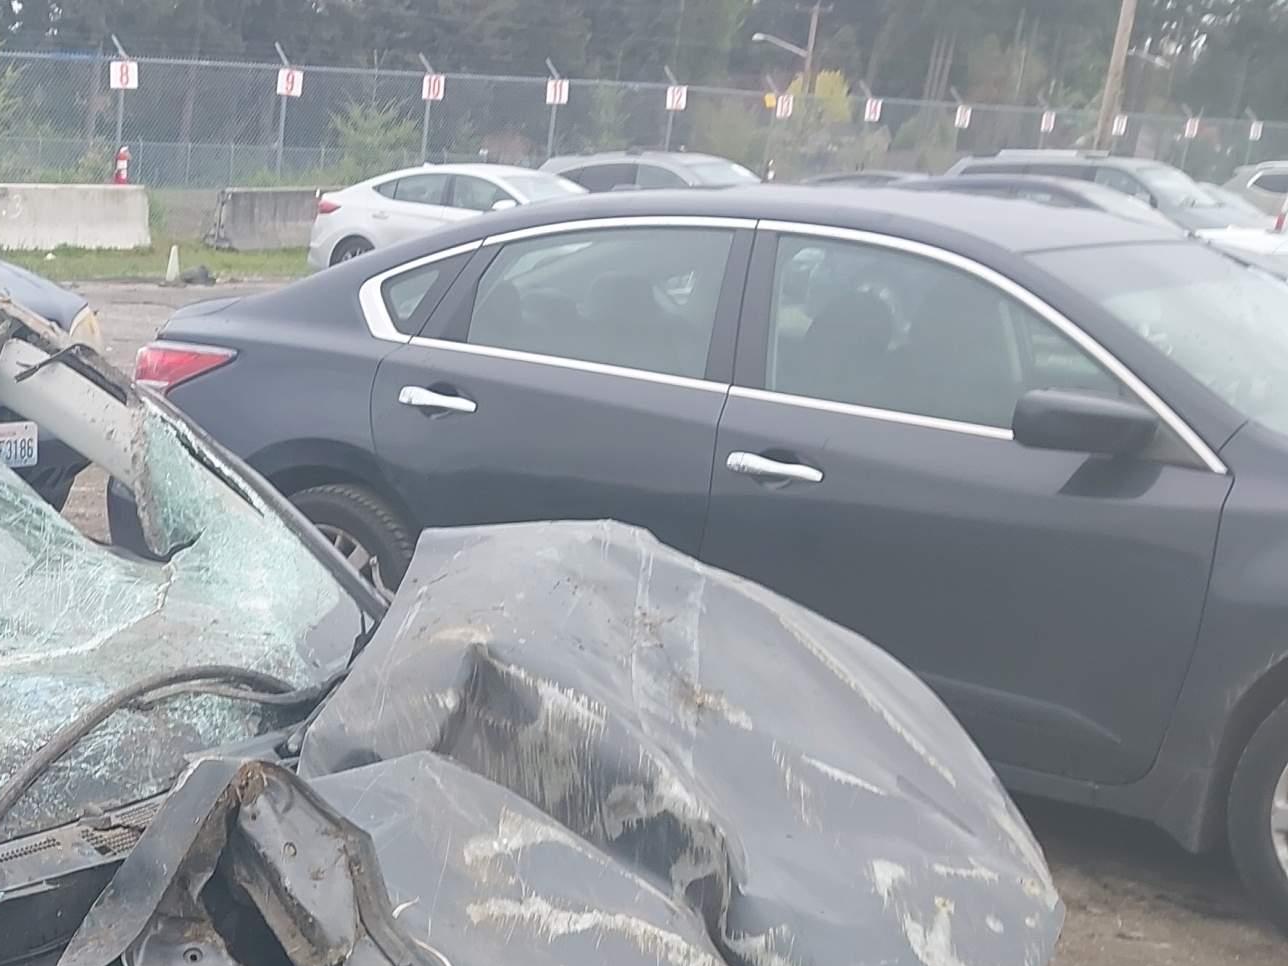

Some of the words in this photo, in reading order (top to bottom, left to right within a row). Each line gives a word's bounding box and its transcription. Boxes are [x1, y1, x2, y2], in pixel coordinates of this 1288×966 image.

[119, 63, 129, 86] 8
[285, 69, 295, 93] 9
[427, 75, 440, 98] 10
[552, 80, 563, 103] 11
